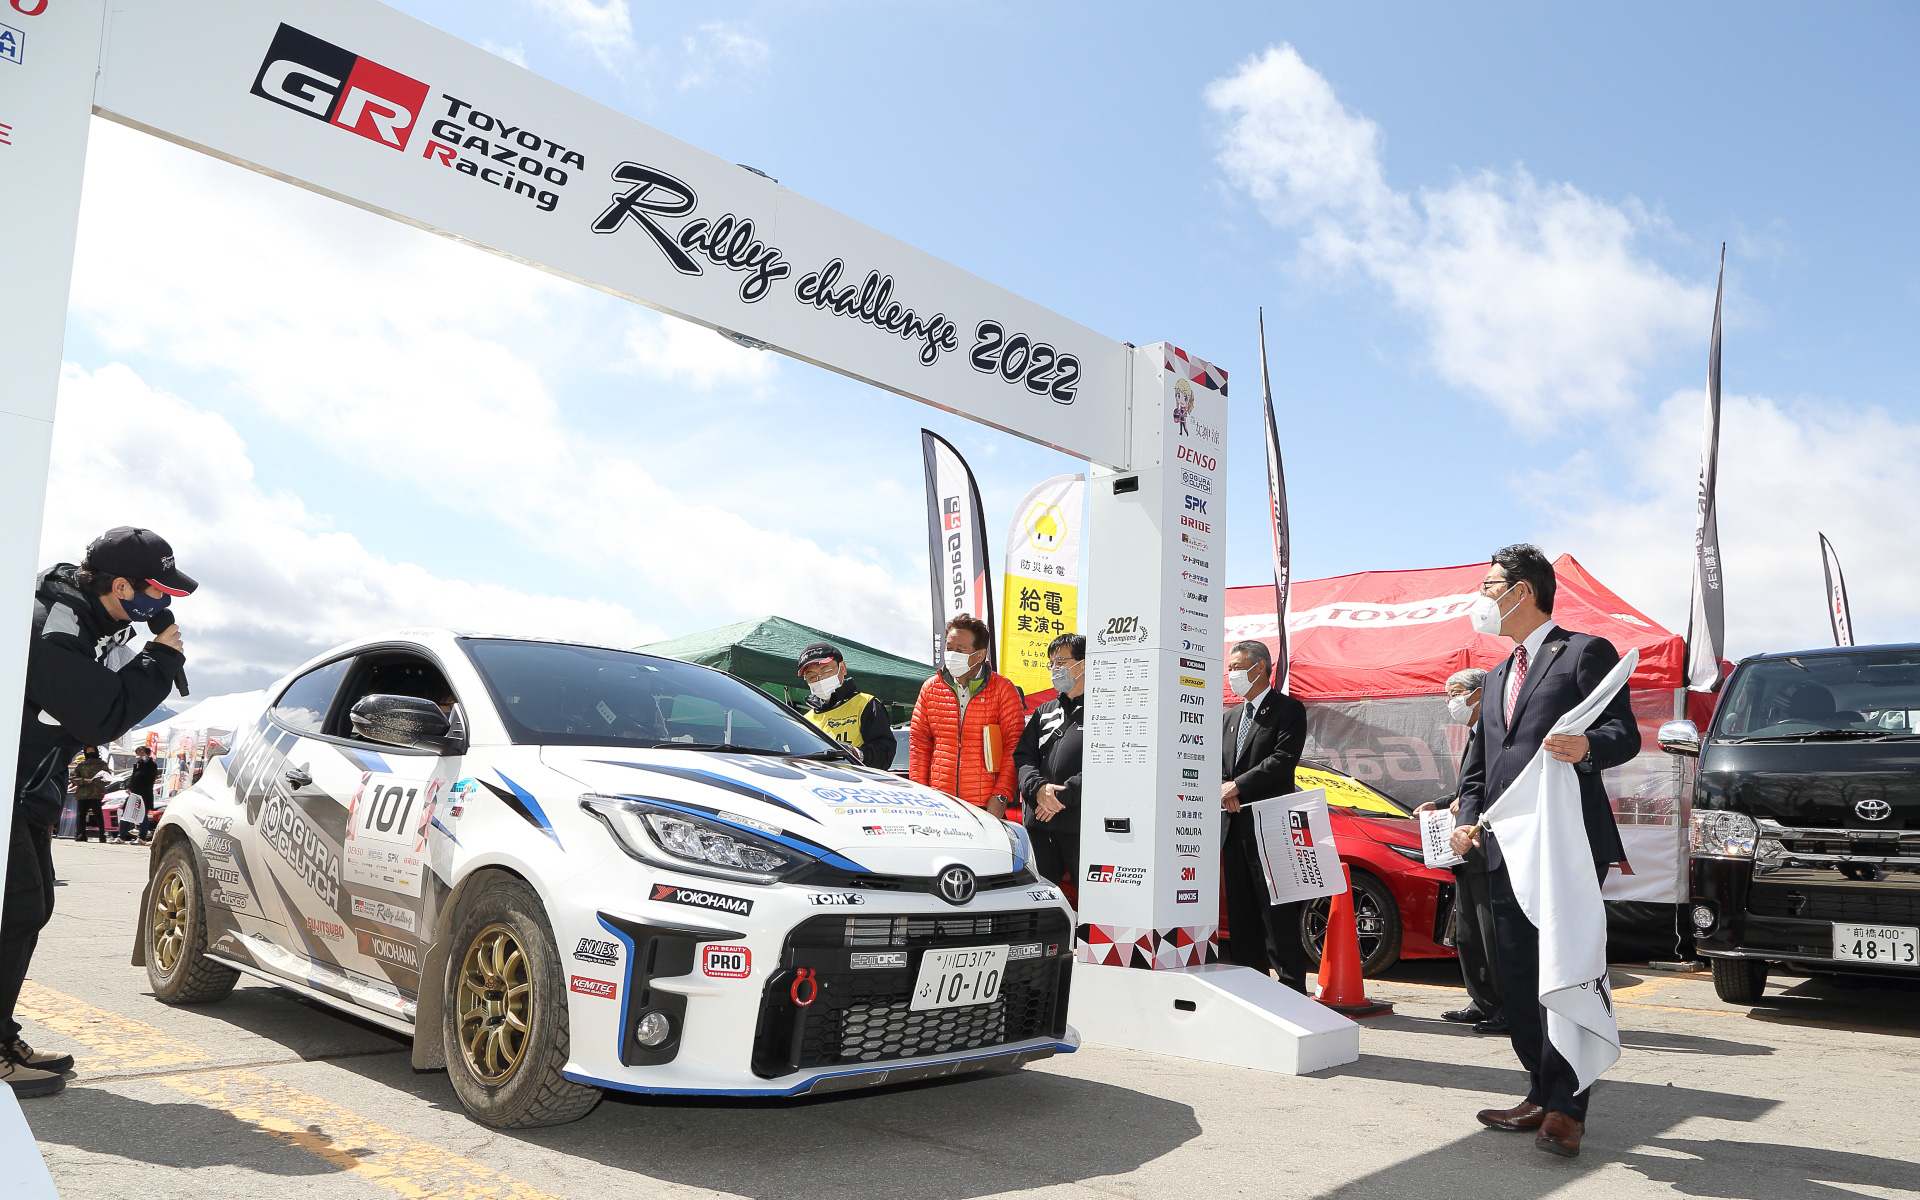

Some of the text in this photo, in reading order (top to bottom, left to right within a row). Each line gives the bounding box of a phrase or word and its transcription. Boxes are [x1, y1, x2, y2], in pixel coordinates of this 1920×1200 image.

[261, 59, 412, 146] GR
[442, 94, 585, 171] TOYOTA
[432, 119, 568, 187] GAZOO
[423, 140, 559, 212] Racing
[591, 161, 1081, 405] Rally challenge 2022
[1177, 445, 1216, 471] DENSO
[1189, 474, 1210, 486] OGURA
[1189, 480, 1210, 492] CLUTCH
[1185, 495, 1207, 515] SPK
[1181, 515, 1211, 533] BRIDE
[948, 532, 966, 610] Garage
[1020, 559, 1065, 576] 防災給電
[1019, 587, 1062, 615] 給電
[1018, 614, 1065, 635] 実演中
[1106, 616, 1138, 634] 2021
[1180, 694, 1204, 705] AISIN
[1179, 711, 1204, 724] JTEKT
[839, 787, 934, 800] OGURA
[854, 795, 949, 810] CLUTCH
[365, 784, 418, 835] 101
[835, 807, 960, 819] Ogura Racing Clutch
[203, 815, 234, 832] TOM'S
[908, 825, 941, 837] Rally
[1290, 812, 1305, 846] GR
[204, 835, 232, 853] ENDLESS
[281, 802, 341, 886] OGURA
[348, 846, 363, 856] DENSO
[1176, 844, 1200, 853] MIZUHO
[387, 853, 399, 863] SPK
[404, 857, 420, 866] BRIDE
[1296, 849, 1309, 884] Racing
[1302, 849, 1316, 885] GAZOO
[208, 867, 239, 884] BRIDE
[277, 835, 339, 911] CLUTCH
[1087, 871, 1113, 883] GR
[1181, 867, 1195, 880] 3M
[1309, 849, 1324, 888] TOYOTA
[1115, 878, 1141, 886] Racing
[676, 890, 748, 913] YOKOHAMA
[808, 893, 865, 905] TOM'S
[1027, 890, 1059, 901] TOM'S
[377, 903, 394, 923] Rally
[307, 917, 344, 939] FUJITSUBO
[1853, 928, 1899, 939] 前橋400
[372, 937, 418, 967] YOKOHAMA
[576, 938, 619, 957] ENDLESS
[1840, 940, 1914, 962] さ 48-13
[575, 955, 593, 963] Challenge
[711, 954, 741, 969] PRO
[572, 978, 615, 994] KEMITEC
[919, 969, 999, 1004] ふ 10-10
